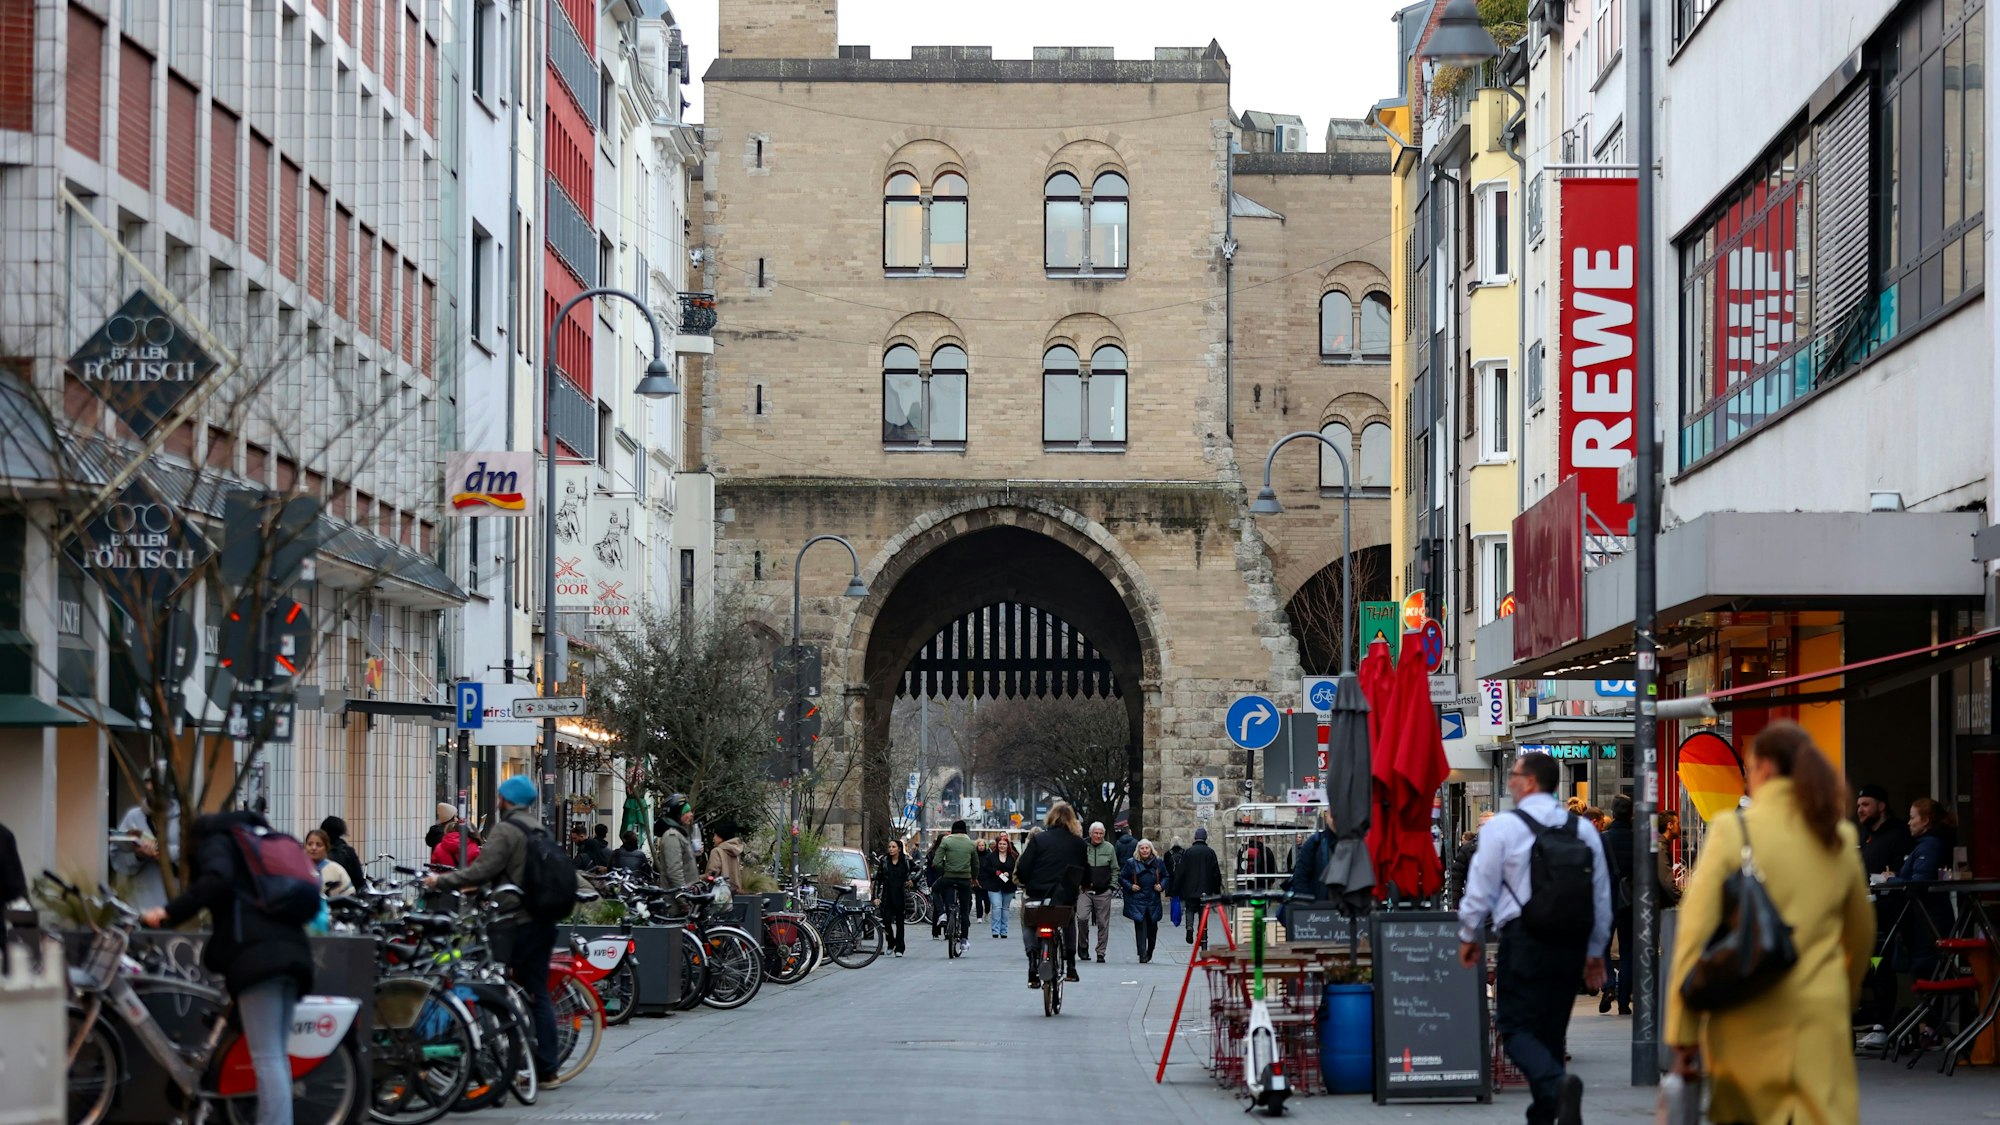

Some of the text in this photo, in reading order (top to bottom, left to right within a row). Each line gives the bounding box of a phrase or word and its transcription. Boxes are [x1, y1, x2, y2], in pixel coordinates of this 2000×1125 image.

[1572, 245, 1634, 468] REWE
[465, 462, 518, 492] dm
[556, 584, 588, 595] OOR
[593, 606, 630, 615] BOOR
[463, 688, 478, 723] P
[593, 949, 607, 957] KVB
